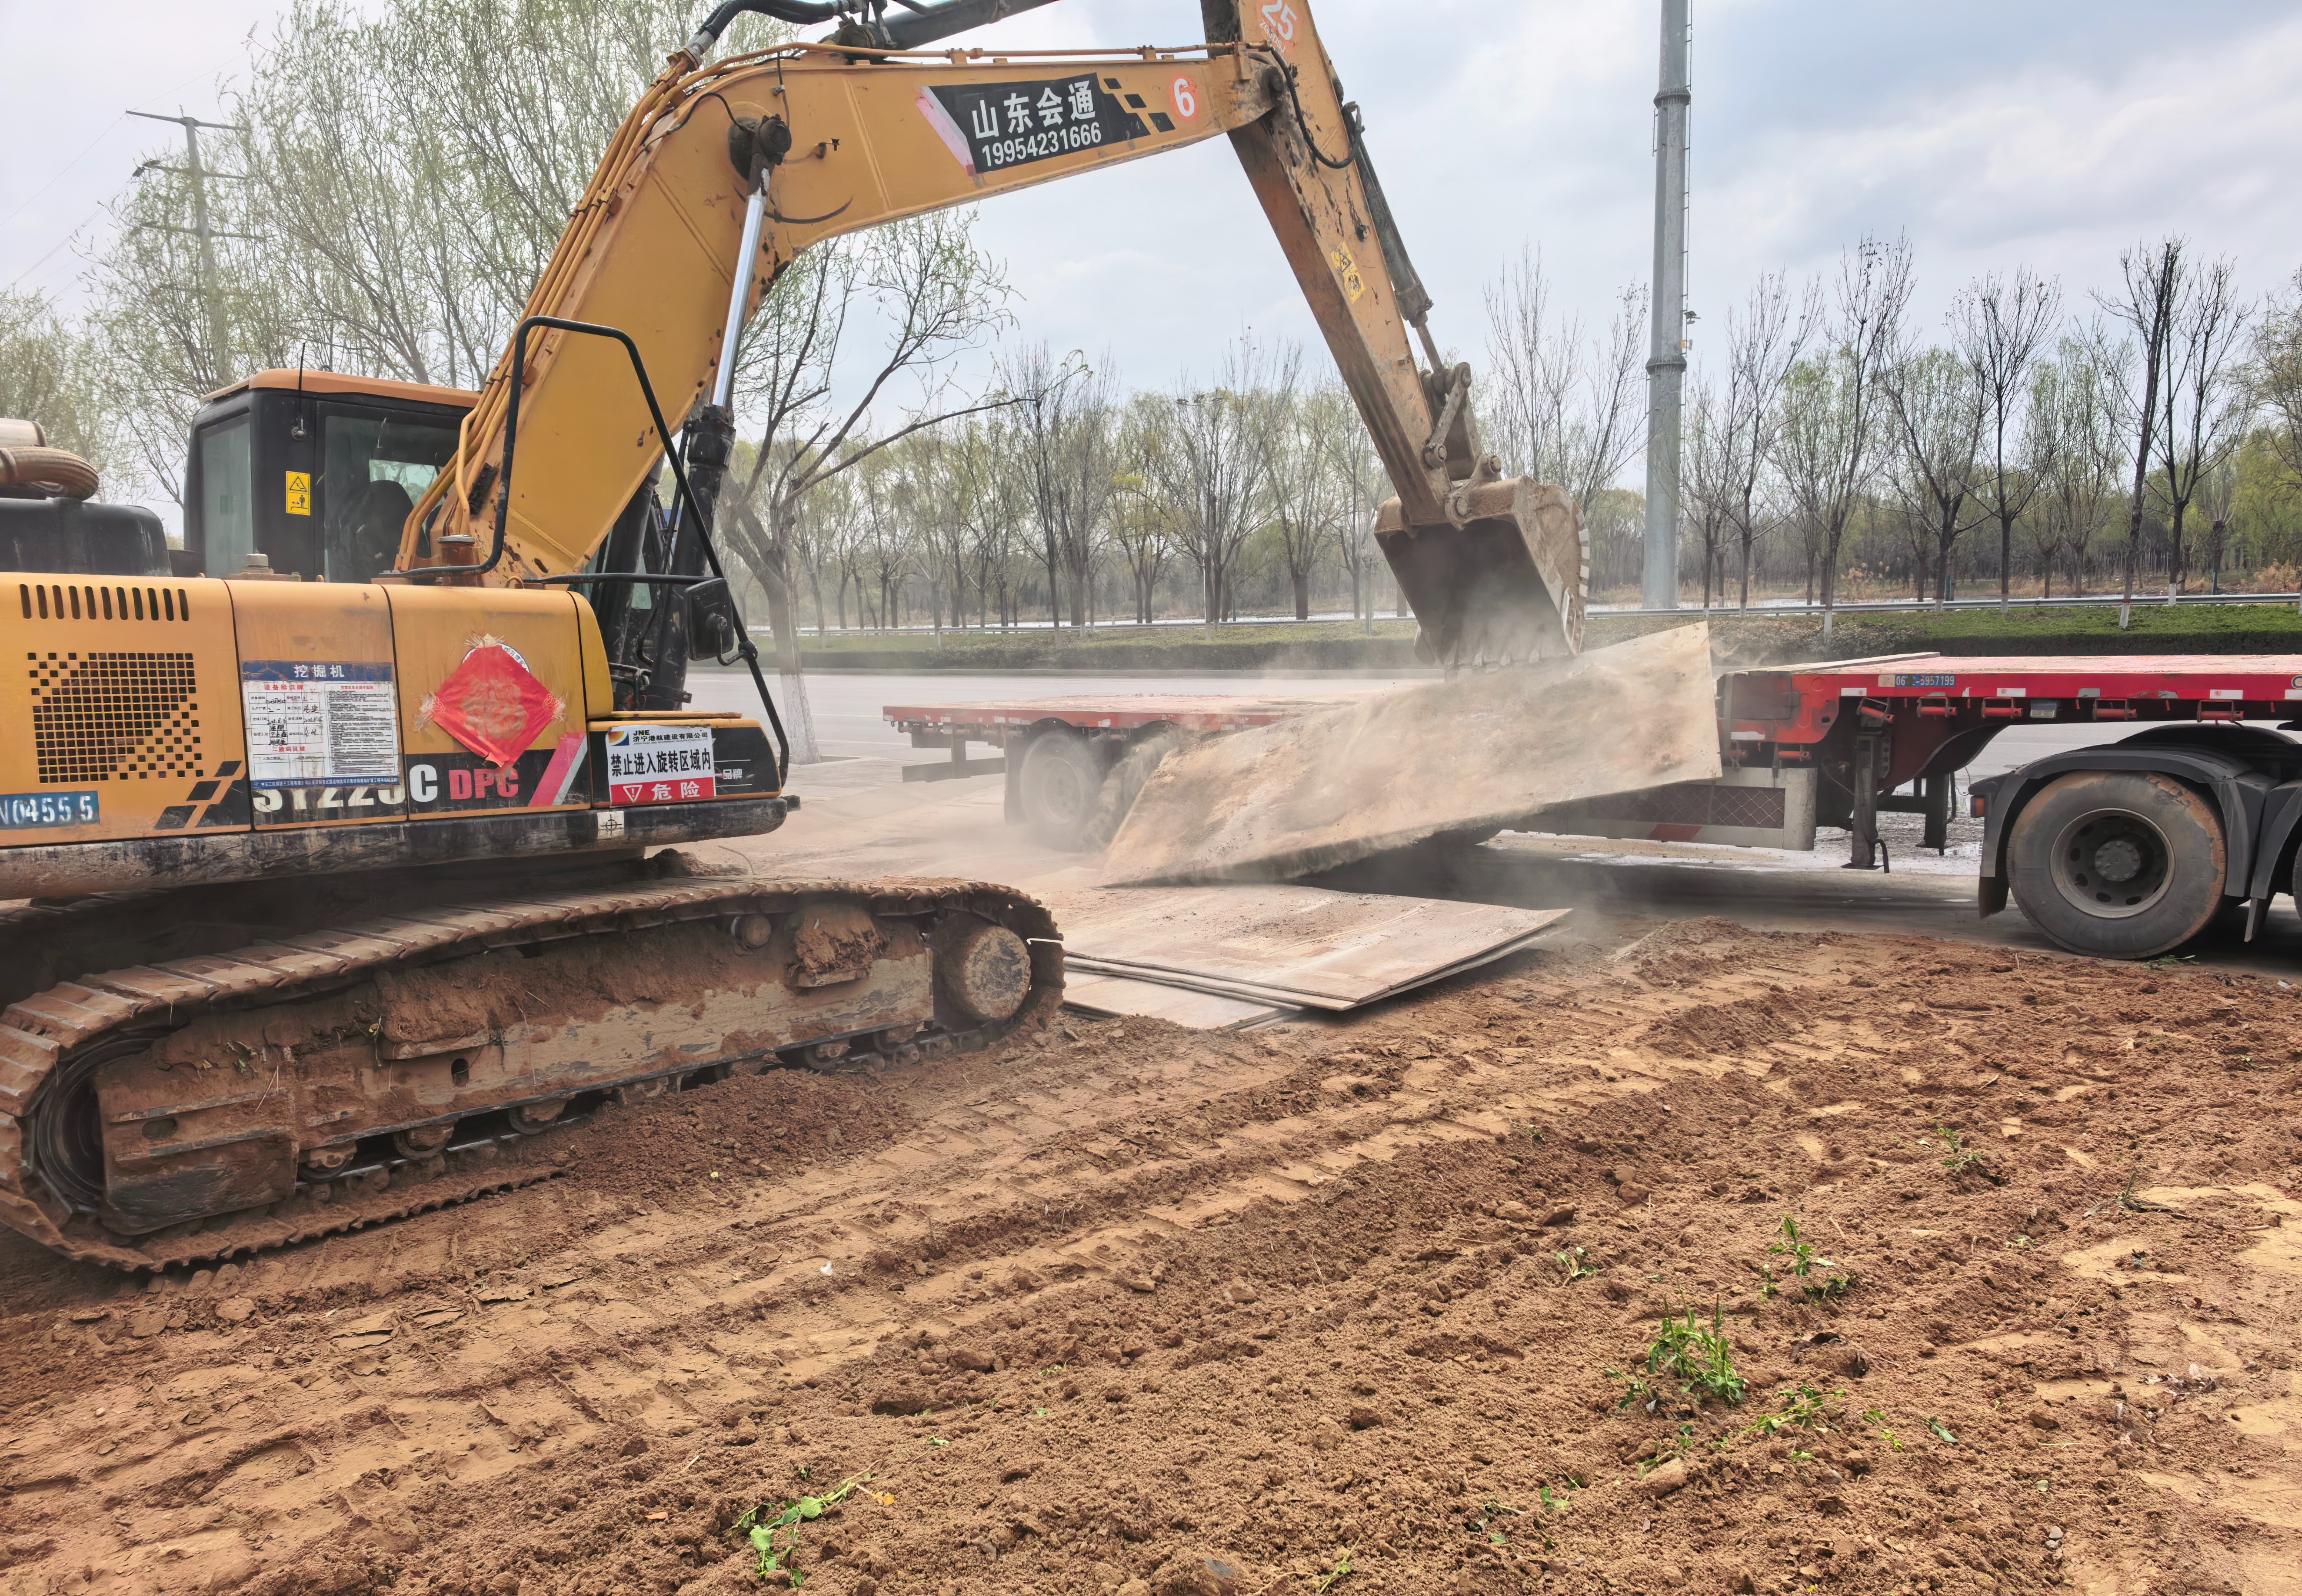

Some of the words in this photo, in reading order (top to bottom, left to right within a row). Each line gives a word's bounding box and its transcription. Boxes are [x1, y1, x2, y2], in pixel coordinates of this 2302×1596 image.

[972, 80, 1097, 140] 山东会通
[1173, 78, 1196, 117] 6
[982, 122, 1101, 167] 19954231666
[294, 664, 345, 678] 挖掘机
[633, 732, 708, 742] 济宁港航建设有限公司
[611, 748, 711, 777] 禁止进入旋转区域内
[723, 768, 742, 779] 品牌
[449, 766, 519, 800] DPC
[651, 781, 701, 801] 危险
